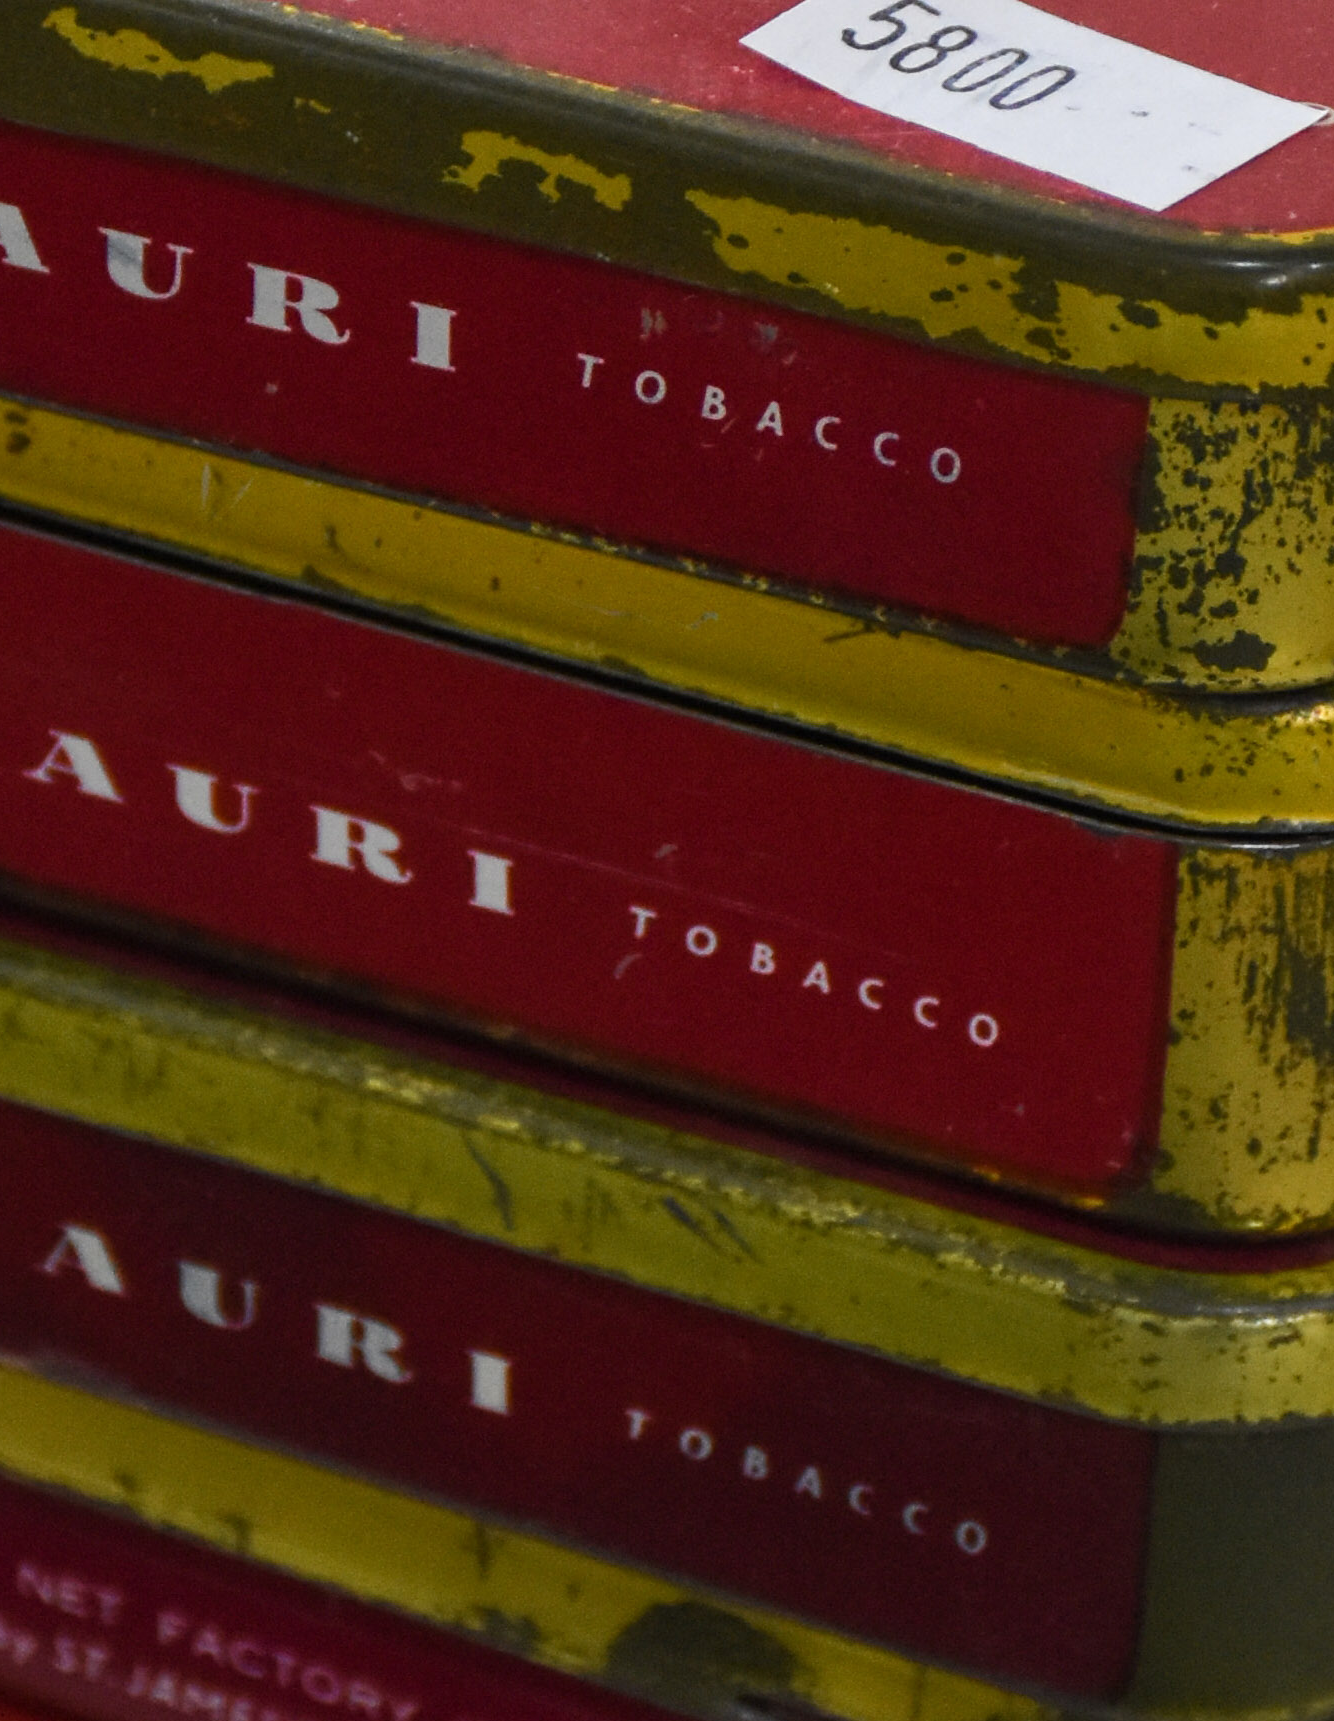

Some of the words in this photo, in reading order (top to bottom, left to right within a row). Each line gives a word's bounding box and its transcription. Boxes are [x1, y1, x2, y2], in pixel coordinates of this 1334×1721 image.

[575, 352, 962, 484] TOBACCO
[628, 905, 1000, 1048] TOBACCO
[625, 1407, 989, 1556] TOBACCO
[17, 1562, 124, 1625] NET
